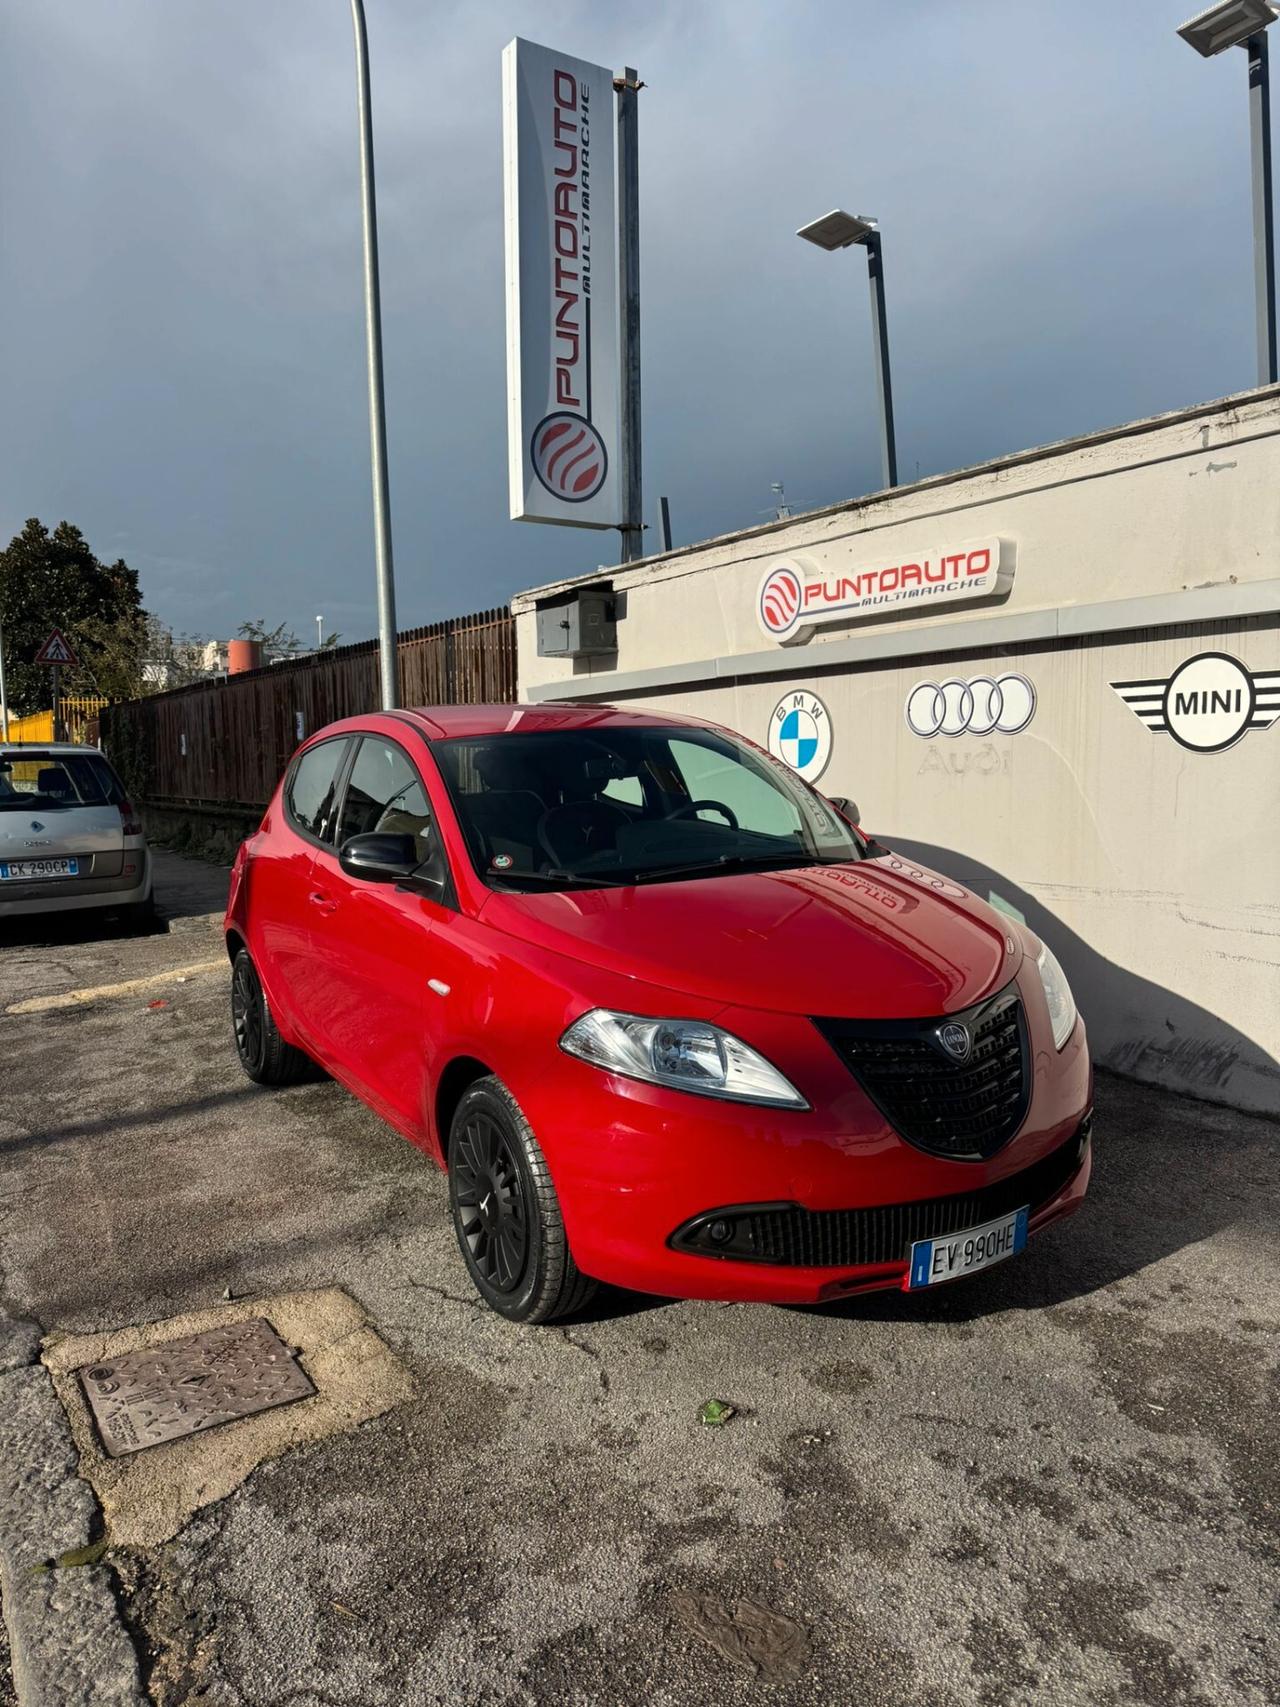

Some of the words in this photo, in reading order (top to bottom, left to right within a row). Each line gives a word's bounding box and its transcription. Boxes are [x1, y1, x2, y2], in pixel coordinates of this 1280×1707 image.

[580, 82, 591, 295] MULTIMARCHE
[554, 69, 580, 406] PUNTOAUTO
[804, 549, 991, 606] PUNTOAUTO
[861, 577, 987, 607] MULTIMARCHE
[776, 694, 823, 722] BMW
[1175, 689, 1242, 715] MINI
[10, 863, 25, 876] CK
[29, 861, 68, 874] 290CP
[933, 1243, 957, 1275] EV
[962, 1222, 1015, 1267] 990HE
